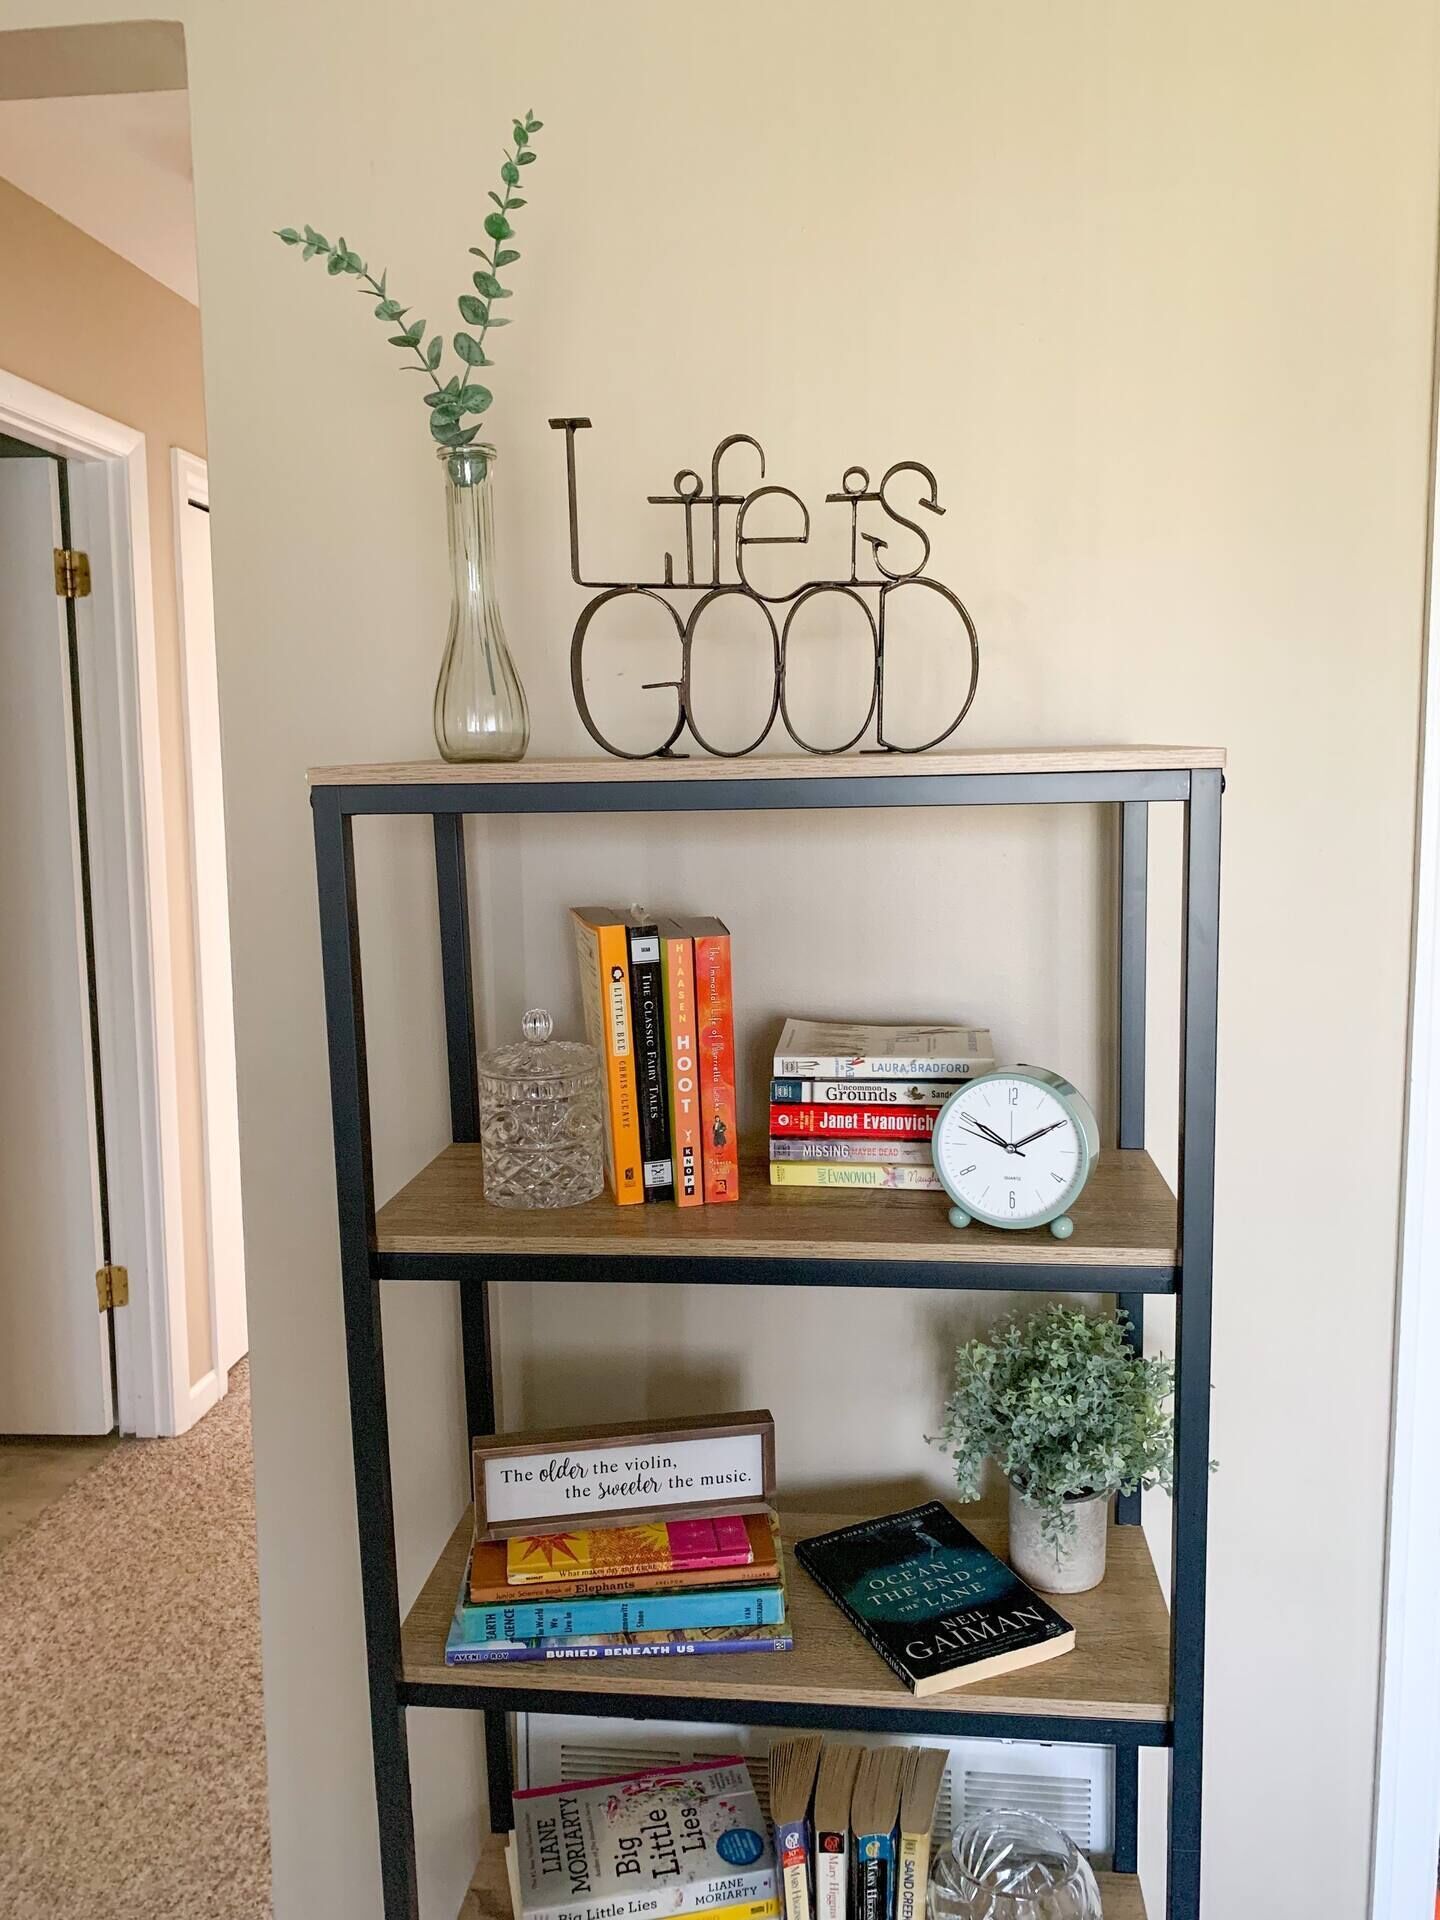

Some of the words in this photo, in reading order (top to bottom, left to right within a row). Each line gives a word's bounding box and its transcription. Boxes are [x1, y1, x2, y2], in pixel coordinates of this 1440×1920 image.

[548, 417, 809, 603] Life
[826, 460, 946, 583] is
[570, 576, 979, 759] GOOD
[709, 946, 720, 961] The
[642, 972, 652, 997] THE
[675, 944, 687, 1023] HIAASEN
[710, 965, 721, 1004] Immortal
[613, 987, 625, 1027] LITTLE
[708, 1008, 722, 1026] Life
[644, 1001, 654, 1047] CLASSIC
[708, 1030, 723, 1039] of
[616, 1032, 626, 1051] BEE
[618, 1060, 627, 1088] CHRIS
[647, 1051, 657, 1081] FAIRY
[677, 1035, 693, 1113] HOOT
[871, 1063, 907, 1073] LAURA
[910, 1063, 970, 1073] BRADFORD
[826, 1086, 898, 1102] Grounds
[837, 1083, 883, 1091] Uncommon
[1008, 1087, 1019, 1106] 12
[621, 1093, 630, 1128] CLEAVE
[649, 1084, 659, 1119] TALES
[820, 1111, 858, 1129] Janet
[863, 1112, 934, 1131] Evanovich
[802, 1143, 850, 1158] MISSING
[851, 1147, 877, 1157] MAYBE
[878, 1148, 899, 1157] DEAD
[684, 1147, 694, 1195] KNOPF
[828, 1168, 877, 1185] EVANOVICH
[908, 1169, 942, 1188] Naugh
[1009, 1190, 1016, 1209] 6
[500, 1469, 533, 1484] The
[539, 1457, 589, 1483] older
[593, 1461, 618, 1475] the
[624, 1456, 677, 1471] violin,
[565, 1486, 591, 1499] the
[598, 1473, 662, 1500] sweeter
[668, 1475, 693, 1489] the
[700, 1469, 752, 1486] music.
[822, 1536, 839, 1544] NEW
[842, 1529, 863, 1540] YORK
[865, 1521, 891, 1532] TIMES
[892, 1506, 940, 1525] BESTSELLER
[559, 1568, 580, 1578] What
[581, 1567, 604, 1576] makes
[868, 1560, 948, 1591] OCEAN
[952, 1557, 963, 1565] AT
[900, 1559, 918, 1568] THE
[495, 1592, 515, 1600] Junior
[518, 1588, 544, 1597] Science
[545, 1587, 562, 1595] Book
[575, 1580, 635, 1594] Elephants
[867, 1585, 918, 1606] THE
[922, 1570, 971, 1592] END
[975, 1566, 987, 1574] OF
[898, 1603, 920, 1613] THE
[922, 1582, 986, 1607] LANE
[485, 1613, 496, 1641] EARTH
[536, 1608, 544, 1628] World
[550, 1617, 558, 1629] We
[564, 1620, 572, 1633] Live
[940, 1610, 990, 1630] NEIL
[905, 1605, 1046, 1660] GAIMAN
[491, 1652, 509, 1660] ROY
[546, 1649, 598, 1659] BURIED
[604, 1646, 670, 1658] BENEATH
[676, 1645, 695, 1653] US
[679, 1806, 707, 1854] Lies
[536, 1817, 562, 1875] LIANE
[558, 1797, 591, 1895] MORIARTY
[614, 1836, 643, 1878] Big
[640, 1808, 681, 1880] Little
[826, 1855, 839, 1879] Mary
[903, 1859, 916, 1890] SAND
[695, 1886, 757, 1906] MORIARTY
[708, 1877, 744, 1892] LIANE
[586, 1903, 625, 1920] Little
[628, 1899, 658, 1913] Lies
[827, 1882, 840, 1919] Higgins
